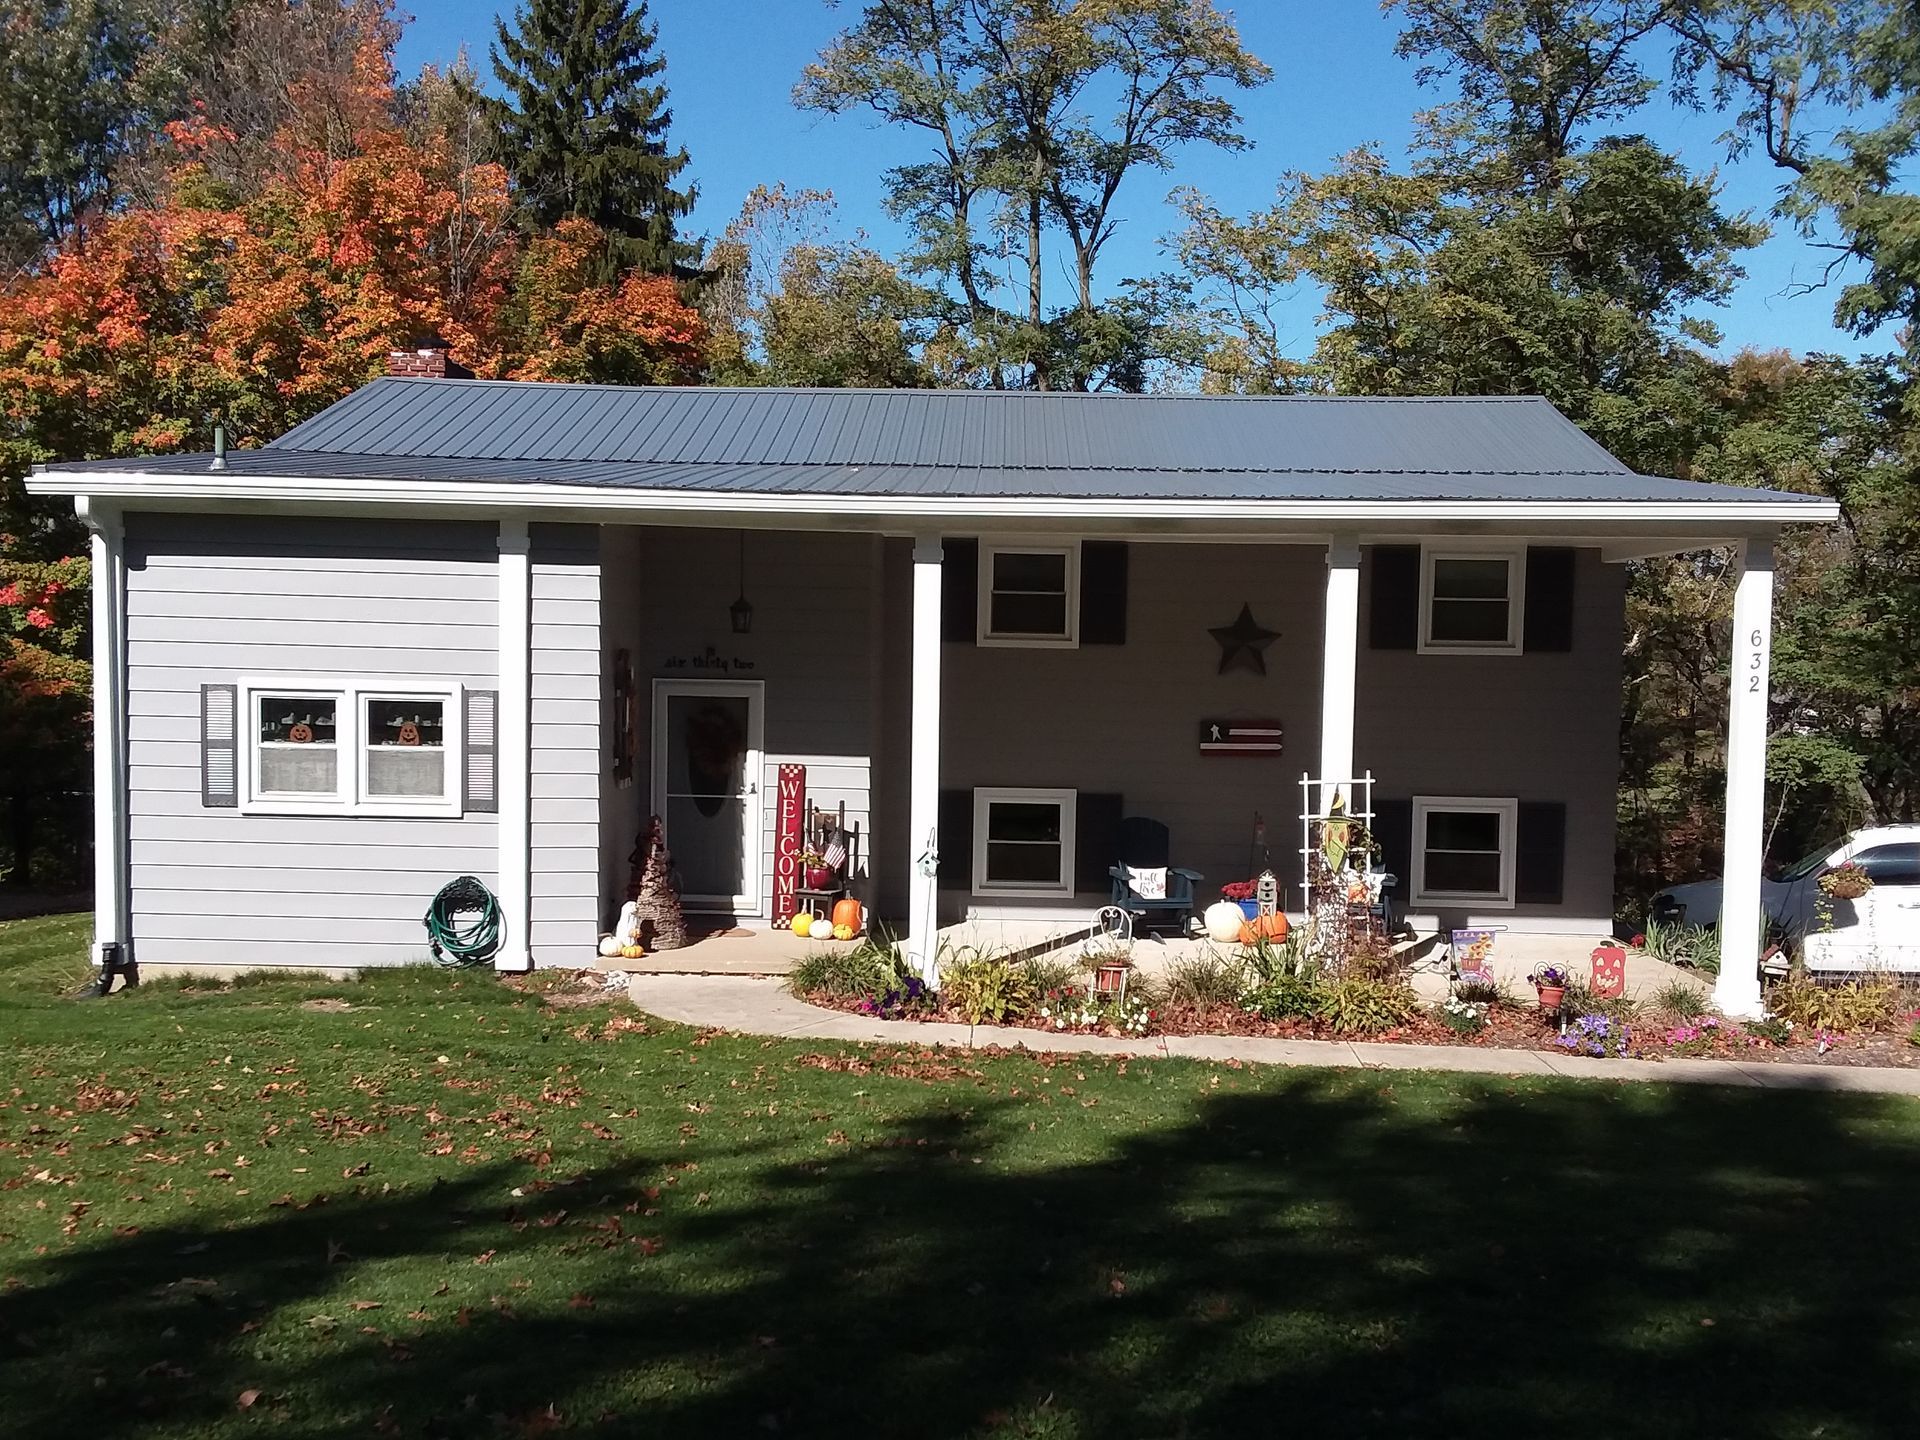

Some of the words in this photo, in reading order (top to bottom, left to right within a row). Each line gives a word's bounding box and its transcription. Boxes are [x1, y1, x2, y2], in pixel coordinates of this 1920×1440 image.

[734, 657, 755, 669] two
[1749, 629, 1762, 693] 632
[777, 780, 800, 913] WELCOME
